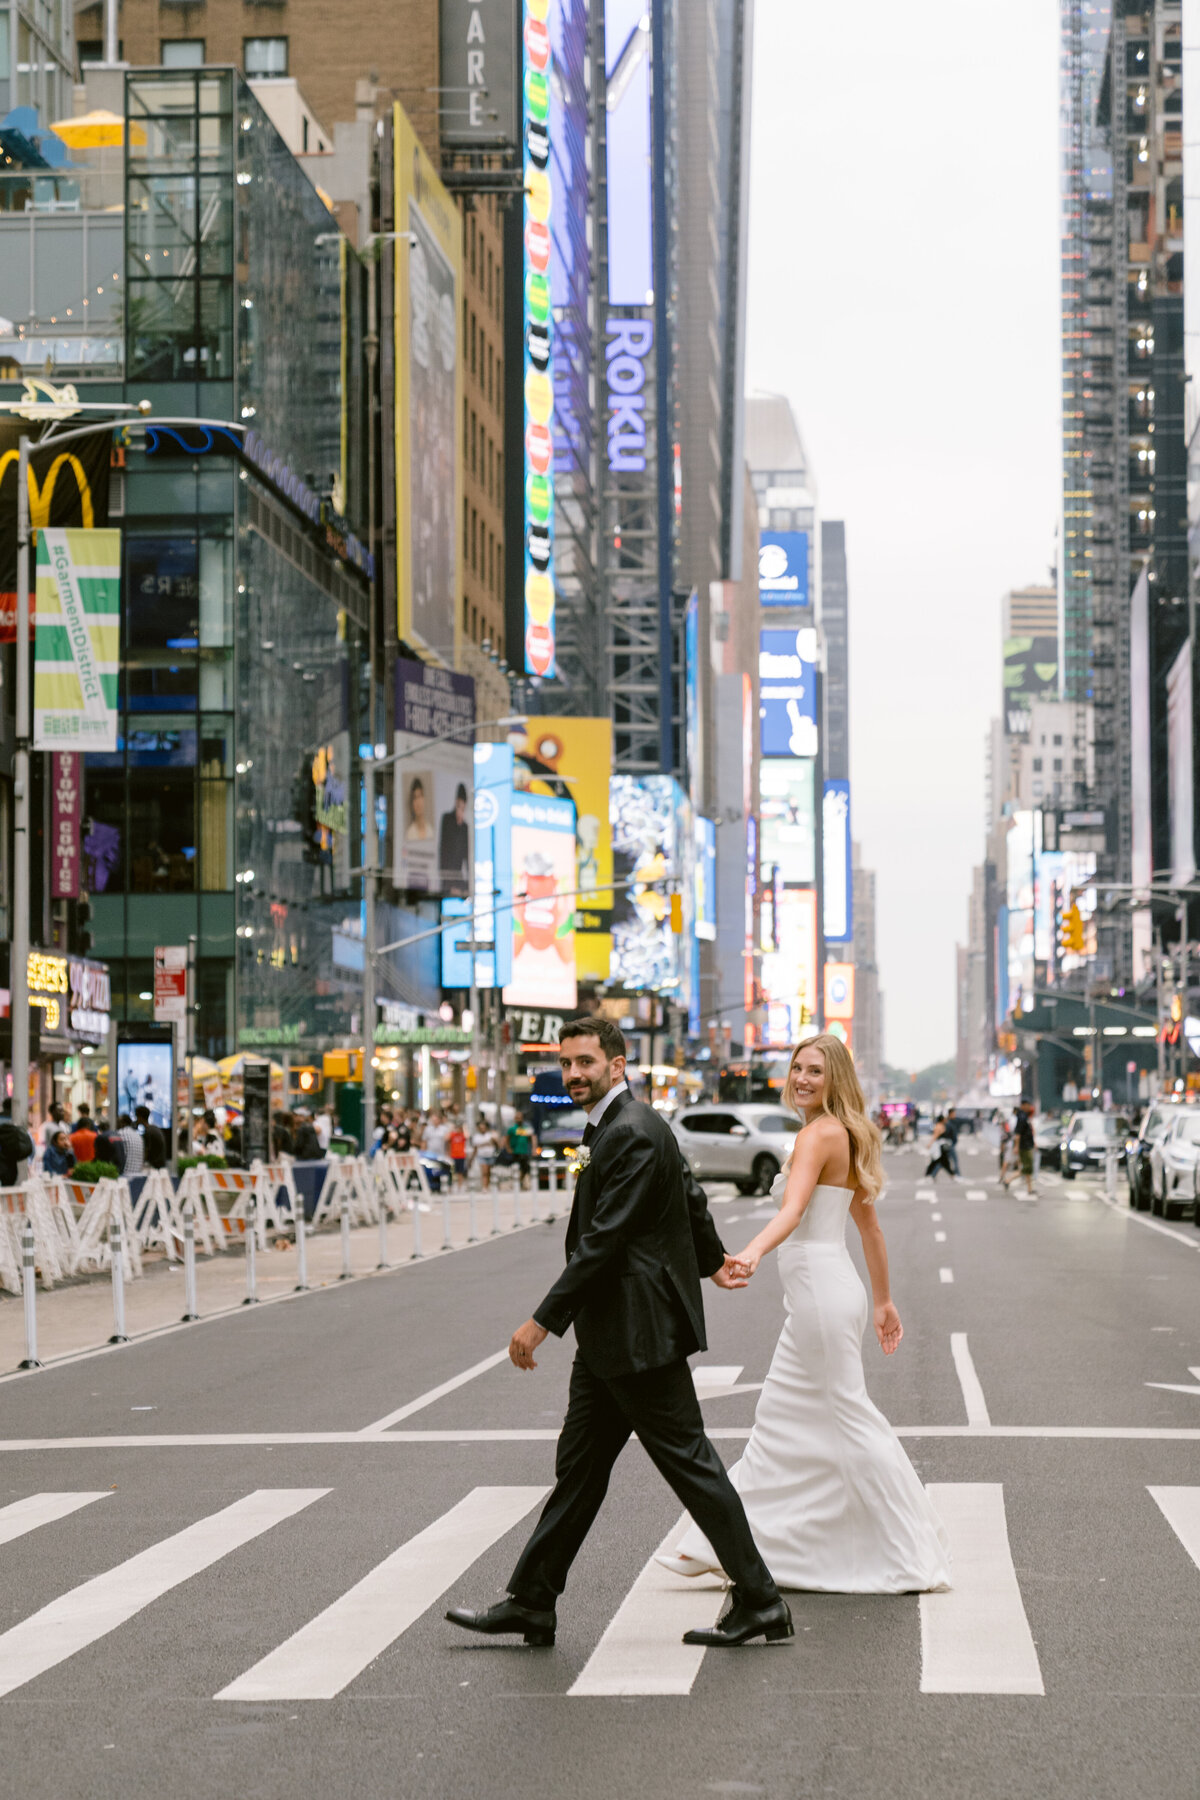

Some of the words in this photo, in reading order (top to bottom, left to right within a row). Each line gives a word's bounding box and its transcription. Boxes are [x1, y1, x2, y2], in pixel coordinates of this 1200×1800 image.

[466, 0, 485, 126] ARE
[52, 544, 98, 701] #GarmentDistrict
[56, 751, 77, 814] DTOWN
[57, 821, 76, 893] COMICS
